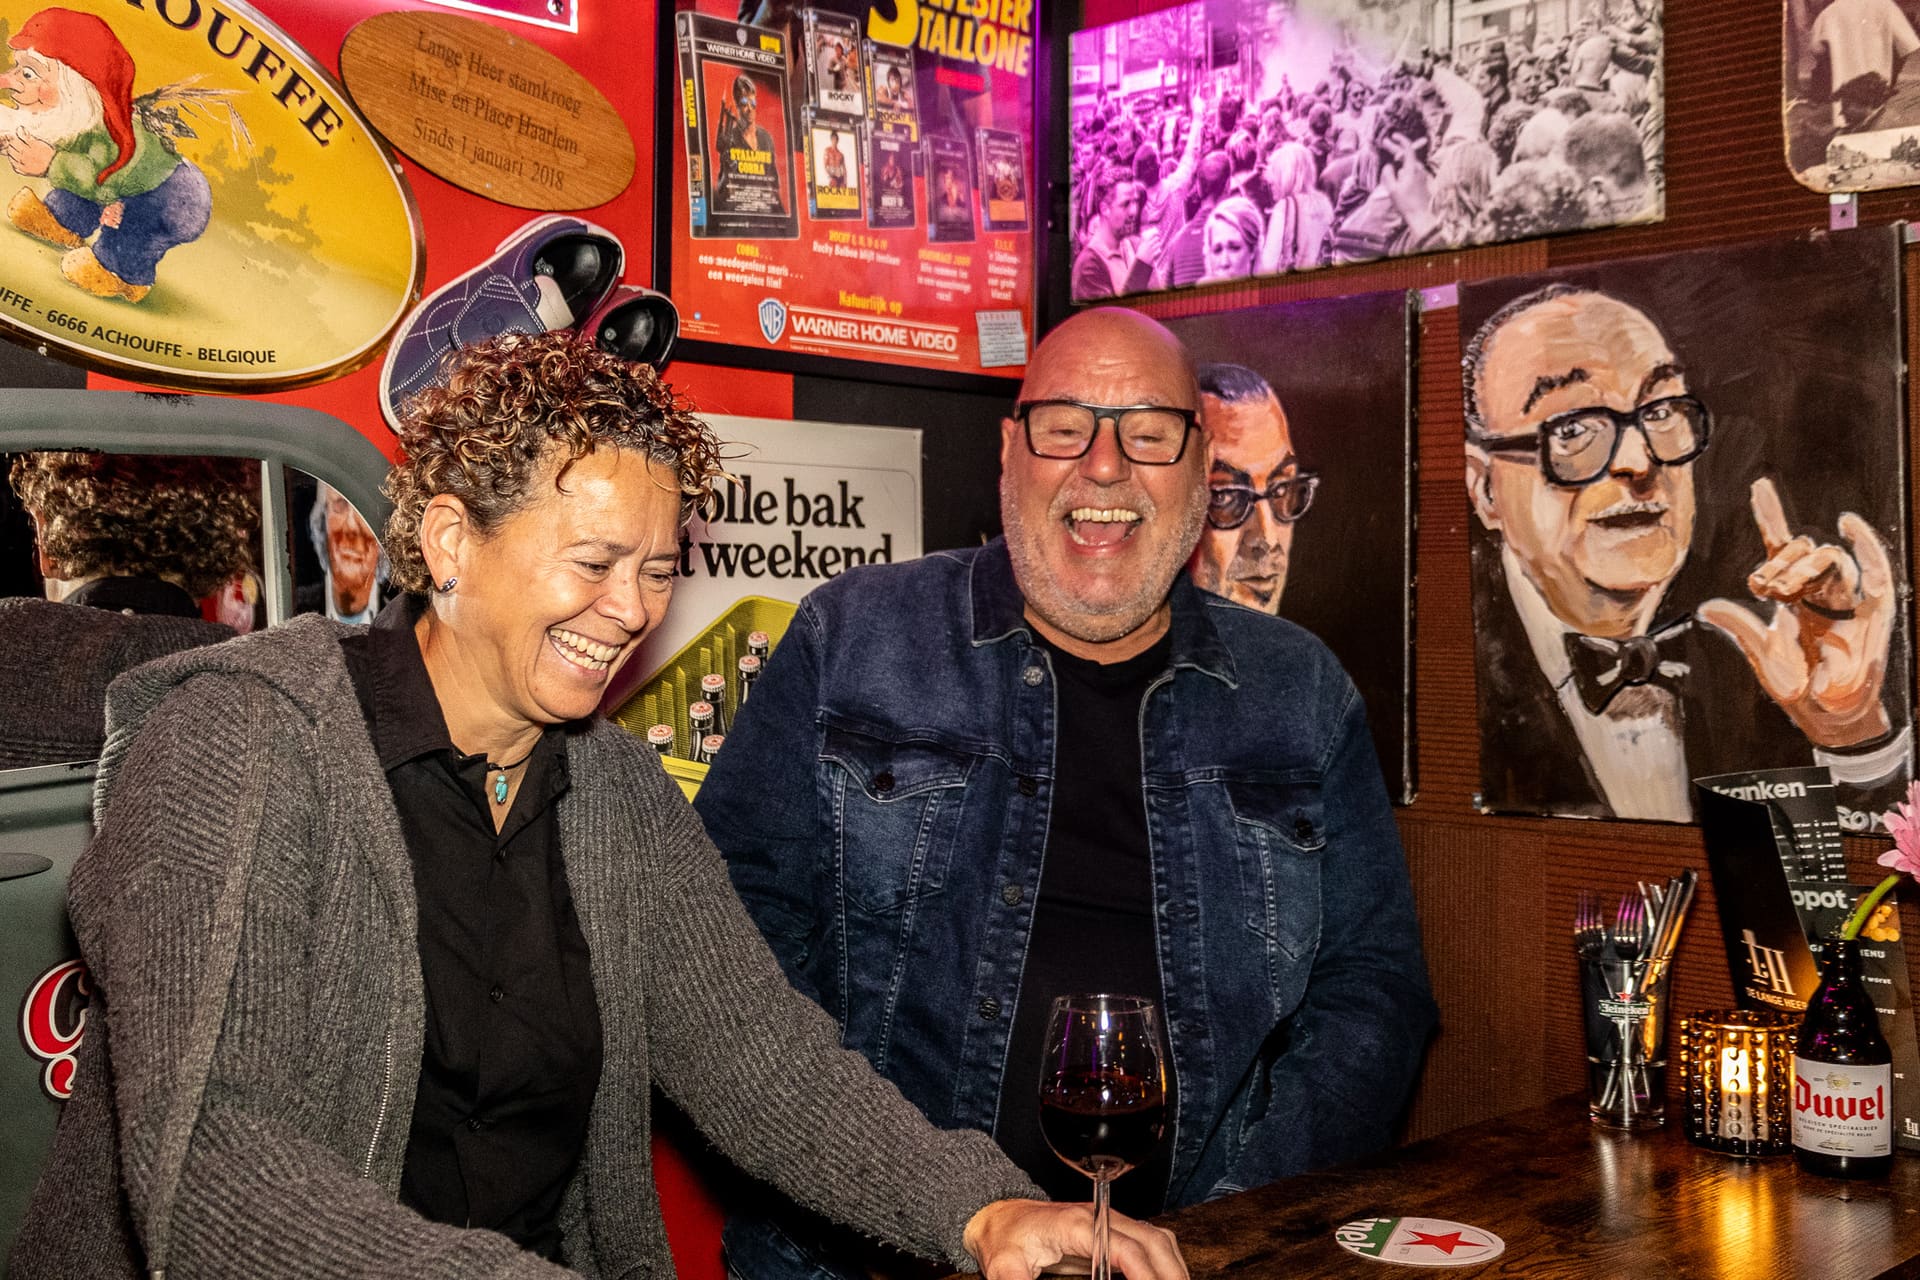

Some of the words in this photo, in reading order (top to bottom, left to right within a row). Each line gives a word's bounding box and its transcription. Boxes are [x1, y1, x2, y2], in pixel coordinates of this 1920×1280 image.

[706, 43, 735, 57] WARNER
[736, 49, 756, 60] HOME
[757, 53, 776, 64] VIDEO
[127, 0, 344, 148] OUFFE
[416, 31, 463, 68] Lange
[469, 52, 505, 83] Heer
[508, 72, 582, 119] stamkroeg
[828, 91, 854, 102] ROCKY
[408, 71, 446, 103] Mise
[451, 93, 469, 112] en
[474, 97, 513, 129] Place
[518, 114, 578, 155] Haarlem
[413, 117, 454, 149] Sinds
[461, 136, 466, 154] 1
[470, 140, 524, 176] januari
[531, 161, 564, 191] 2018
[730, 147, 771, 164] STALLONE
[738, 161, 765, 175] COBRA
[817, 185, 846, 196] ROCKY
[699, 255, 713, 265] een
[736, 243, 759, 257] COBRA
[708, 270, 723, 280] een
[839, 290, 888, 315] Natuurlijk
[890, 301, 903, 317] op
[47, 309, 88, 334] 6666
[91, 326, 183, 358] ACHOUFFE
[198, 348, 276, 364] BELGIQUE
[791, 315, 859, 341] WARNER
[861, 324, 907, 347] HOME
[911, 330, 958, 352] VIDEO
[784, 477, 865, 529] bak
[699, 530, 892, 579] weekend
[1712, 780, 1807, 800] anken
[1600, 1003, 1649, 1015] Heineken
[1756, 989, 1784, 1006] LANGE
[1785, 997, 1808, 1011] HEER
[1795, 1074, 1885, 1121] Duvel
